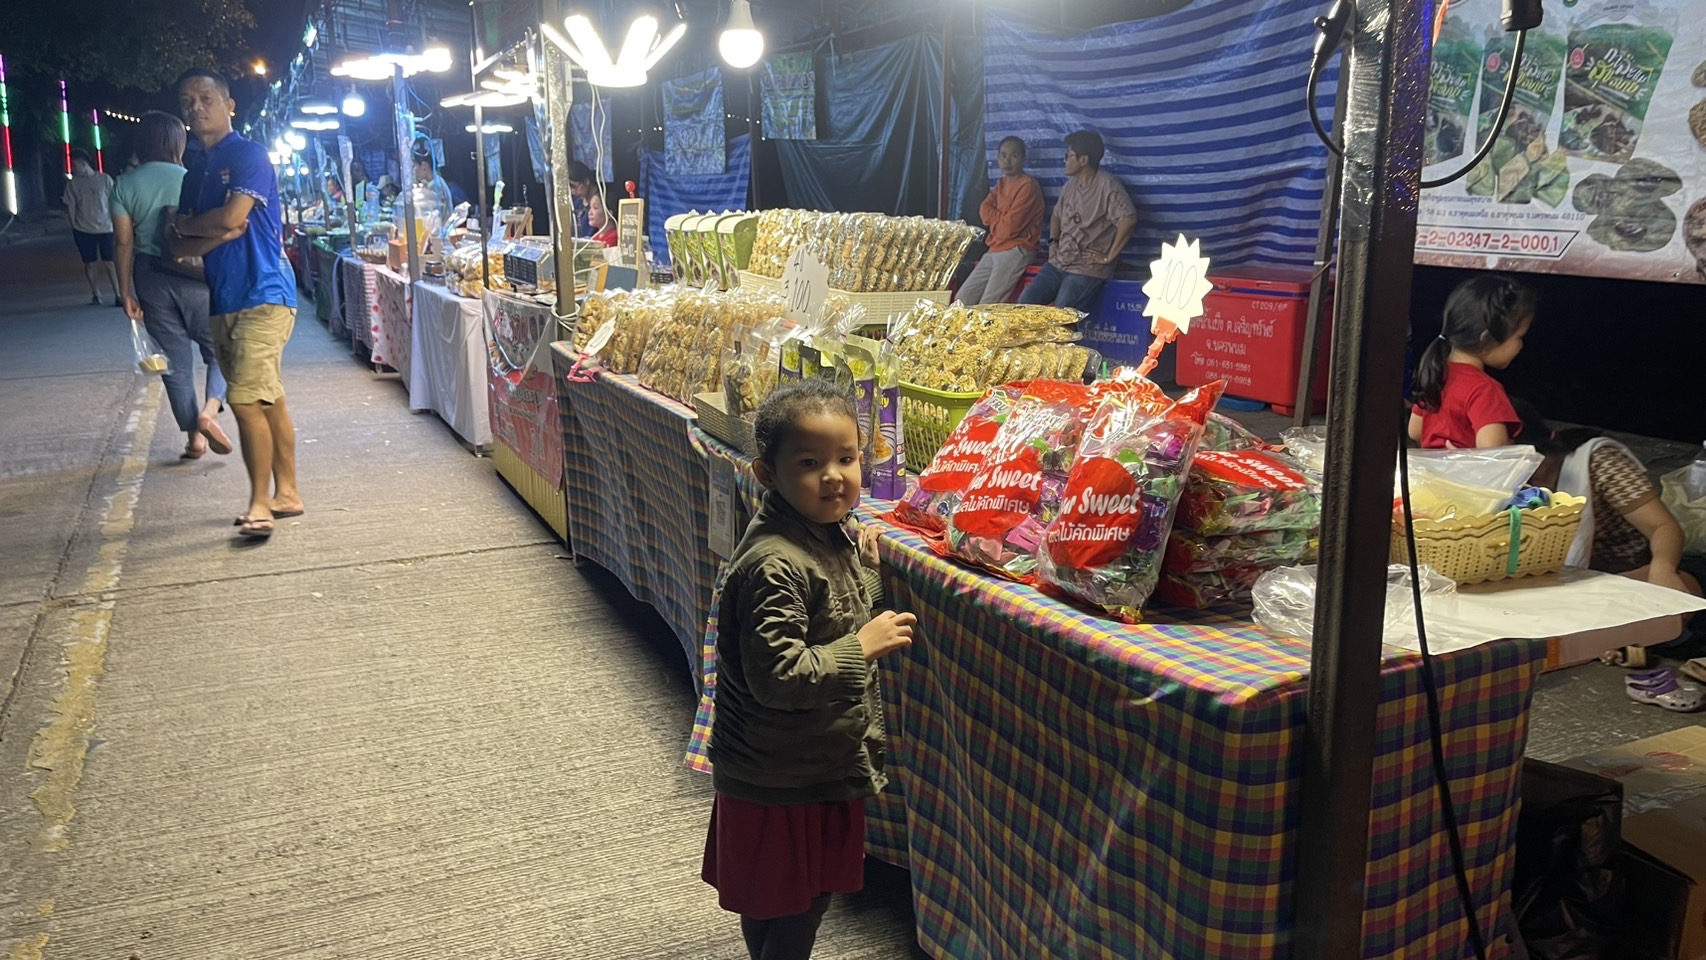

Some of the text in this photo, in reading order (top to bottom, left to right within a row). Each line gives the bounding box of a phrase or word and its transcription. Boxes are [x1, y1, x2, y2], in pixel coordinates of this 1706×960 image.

[1415, 230, 1559, 251] -2-02347-2-0001
[789, 277, 811, 313] 100
[1156, 257, 1198, 310] 100
[989, 398, 1009, 411] FRU
[988, 465, 1042, 491] Sweet
[953, 494, 1031, 515] ลไม้คัดพิเศษ
[1060, 485, 1142, 517] ur Sweet
